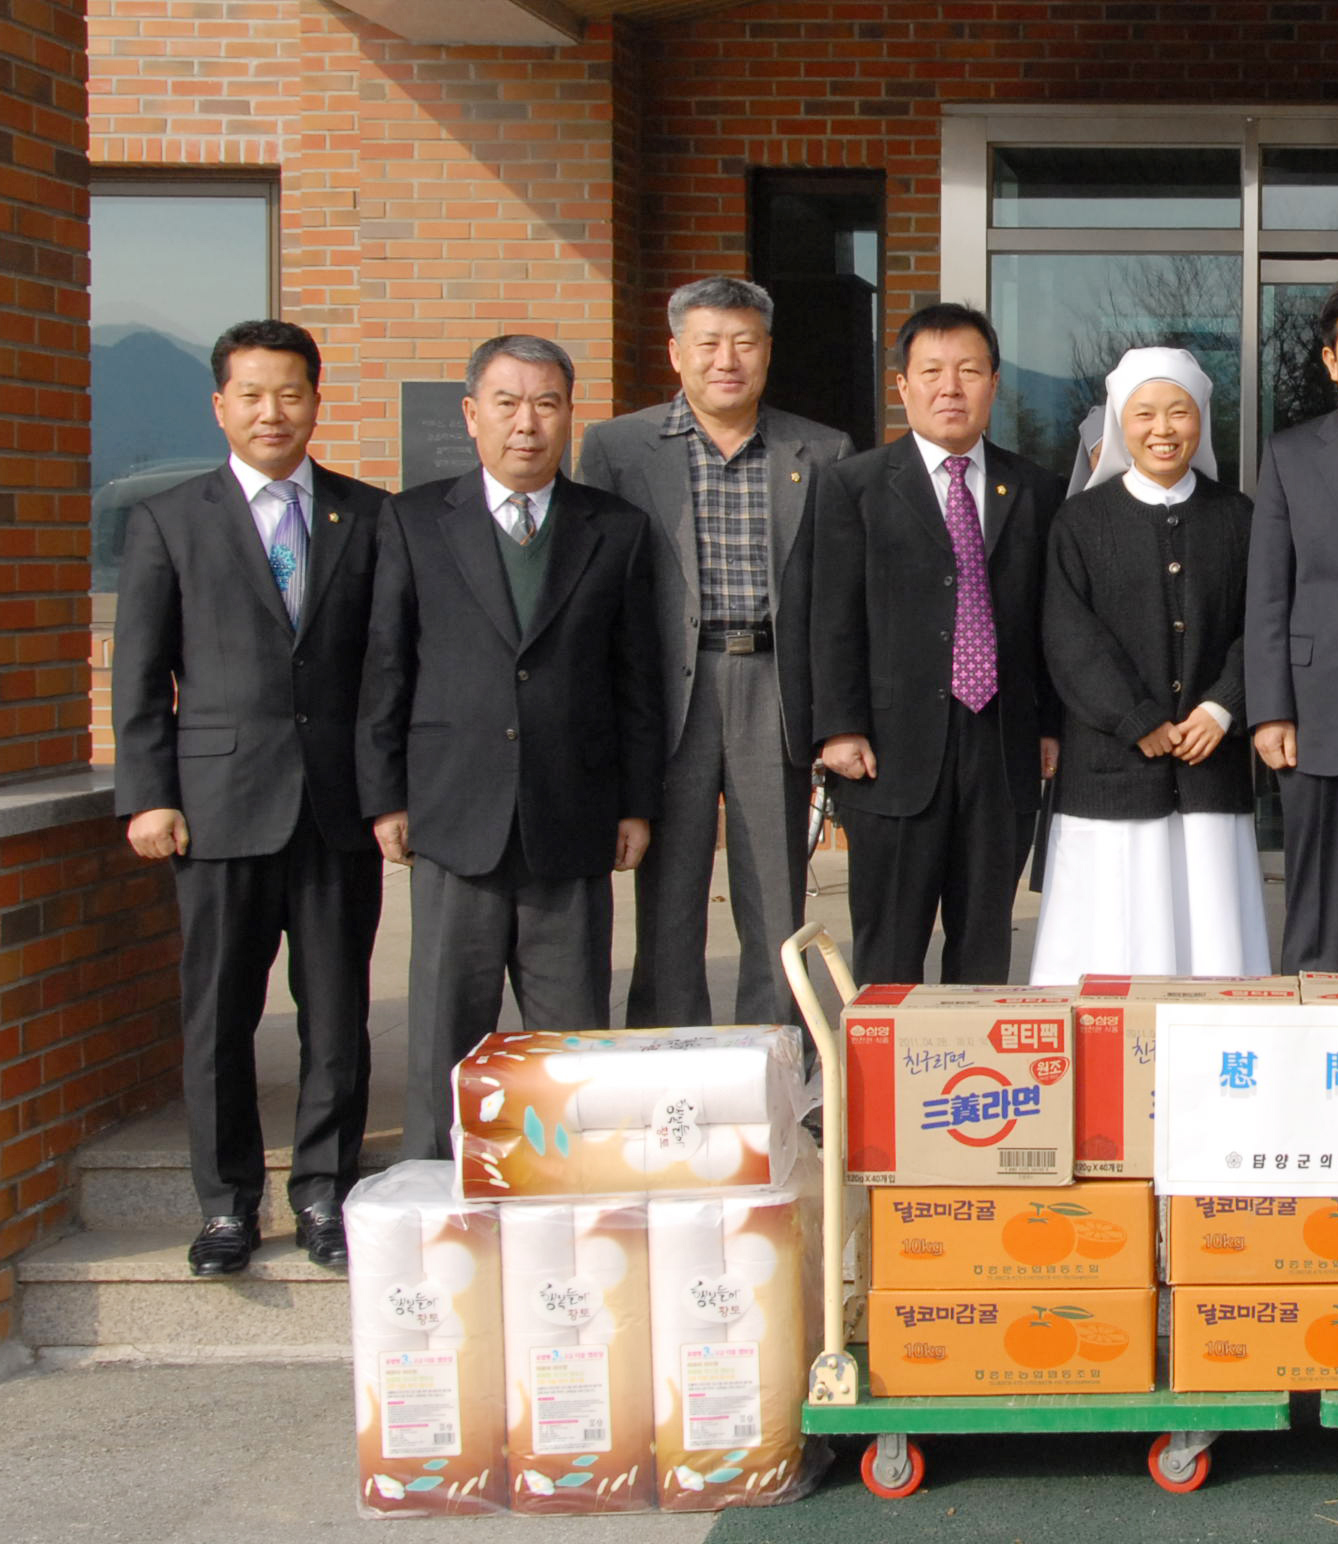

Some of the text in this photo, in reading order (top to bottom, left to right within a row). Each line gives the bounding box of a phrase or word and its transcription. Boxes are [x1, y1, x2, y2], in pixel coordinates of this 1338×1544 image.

[1000, 1022, 1059, 1049] 멀티팩
[903, 1048, 974, 1075] 친구라면
[1036, 1061, 1062, 1078] 원조
[893, 1200, 996, 1223] 달코미감귤
[901, 1238, 944, 1256] 10kg
[1203, 1233, 1245, 1251] 10kg
[895, 1303, 999, 1327] 달코미감귤
[1196, 1302, 1299, 1326] 달코미감귤
[904, 1342, 946, 1360] 10kg
[1205, 1340, 1248, 1358] 10kg
